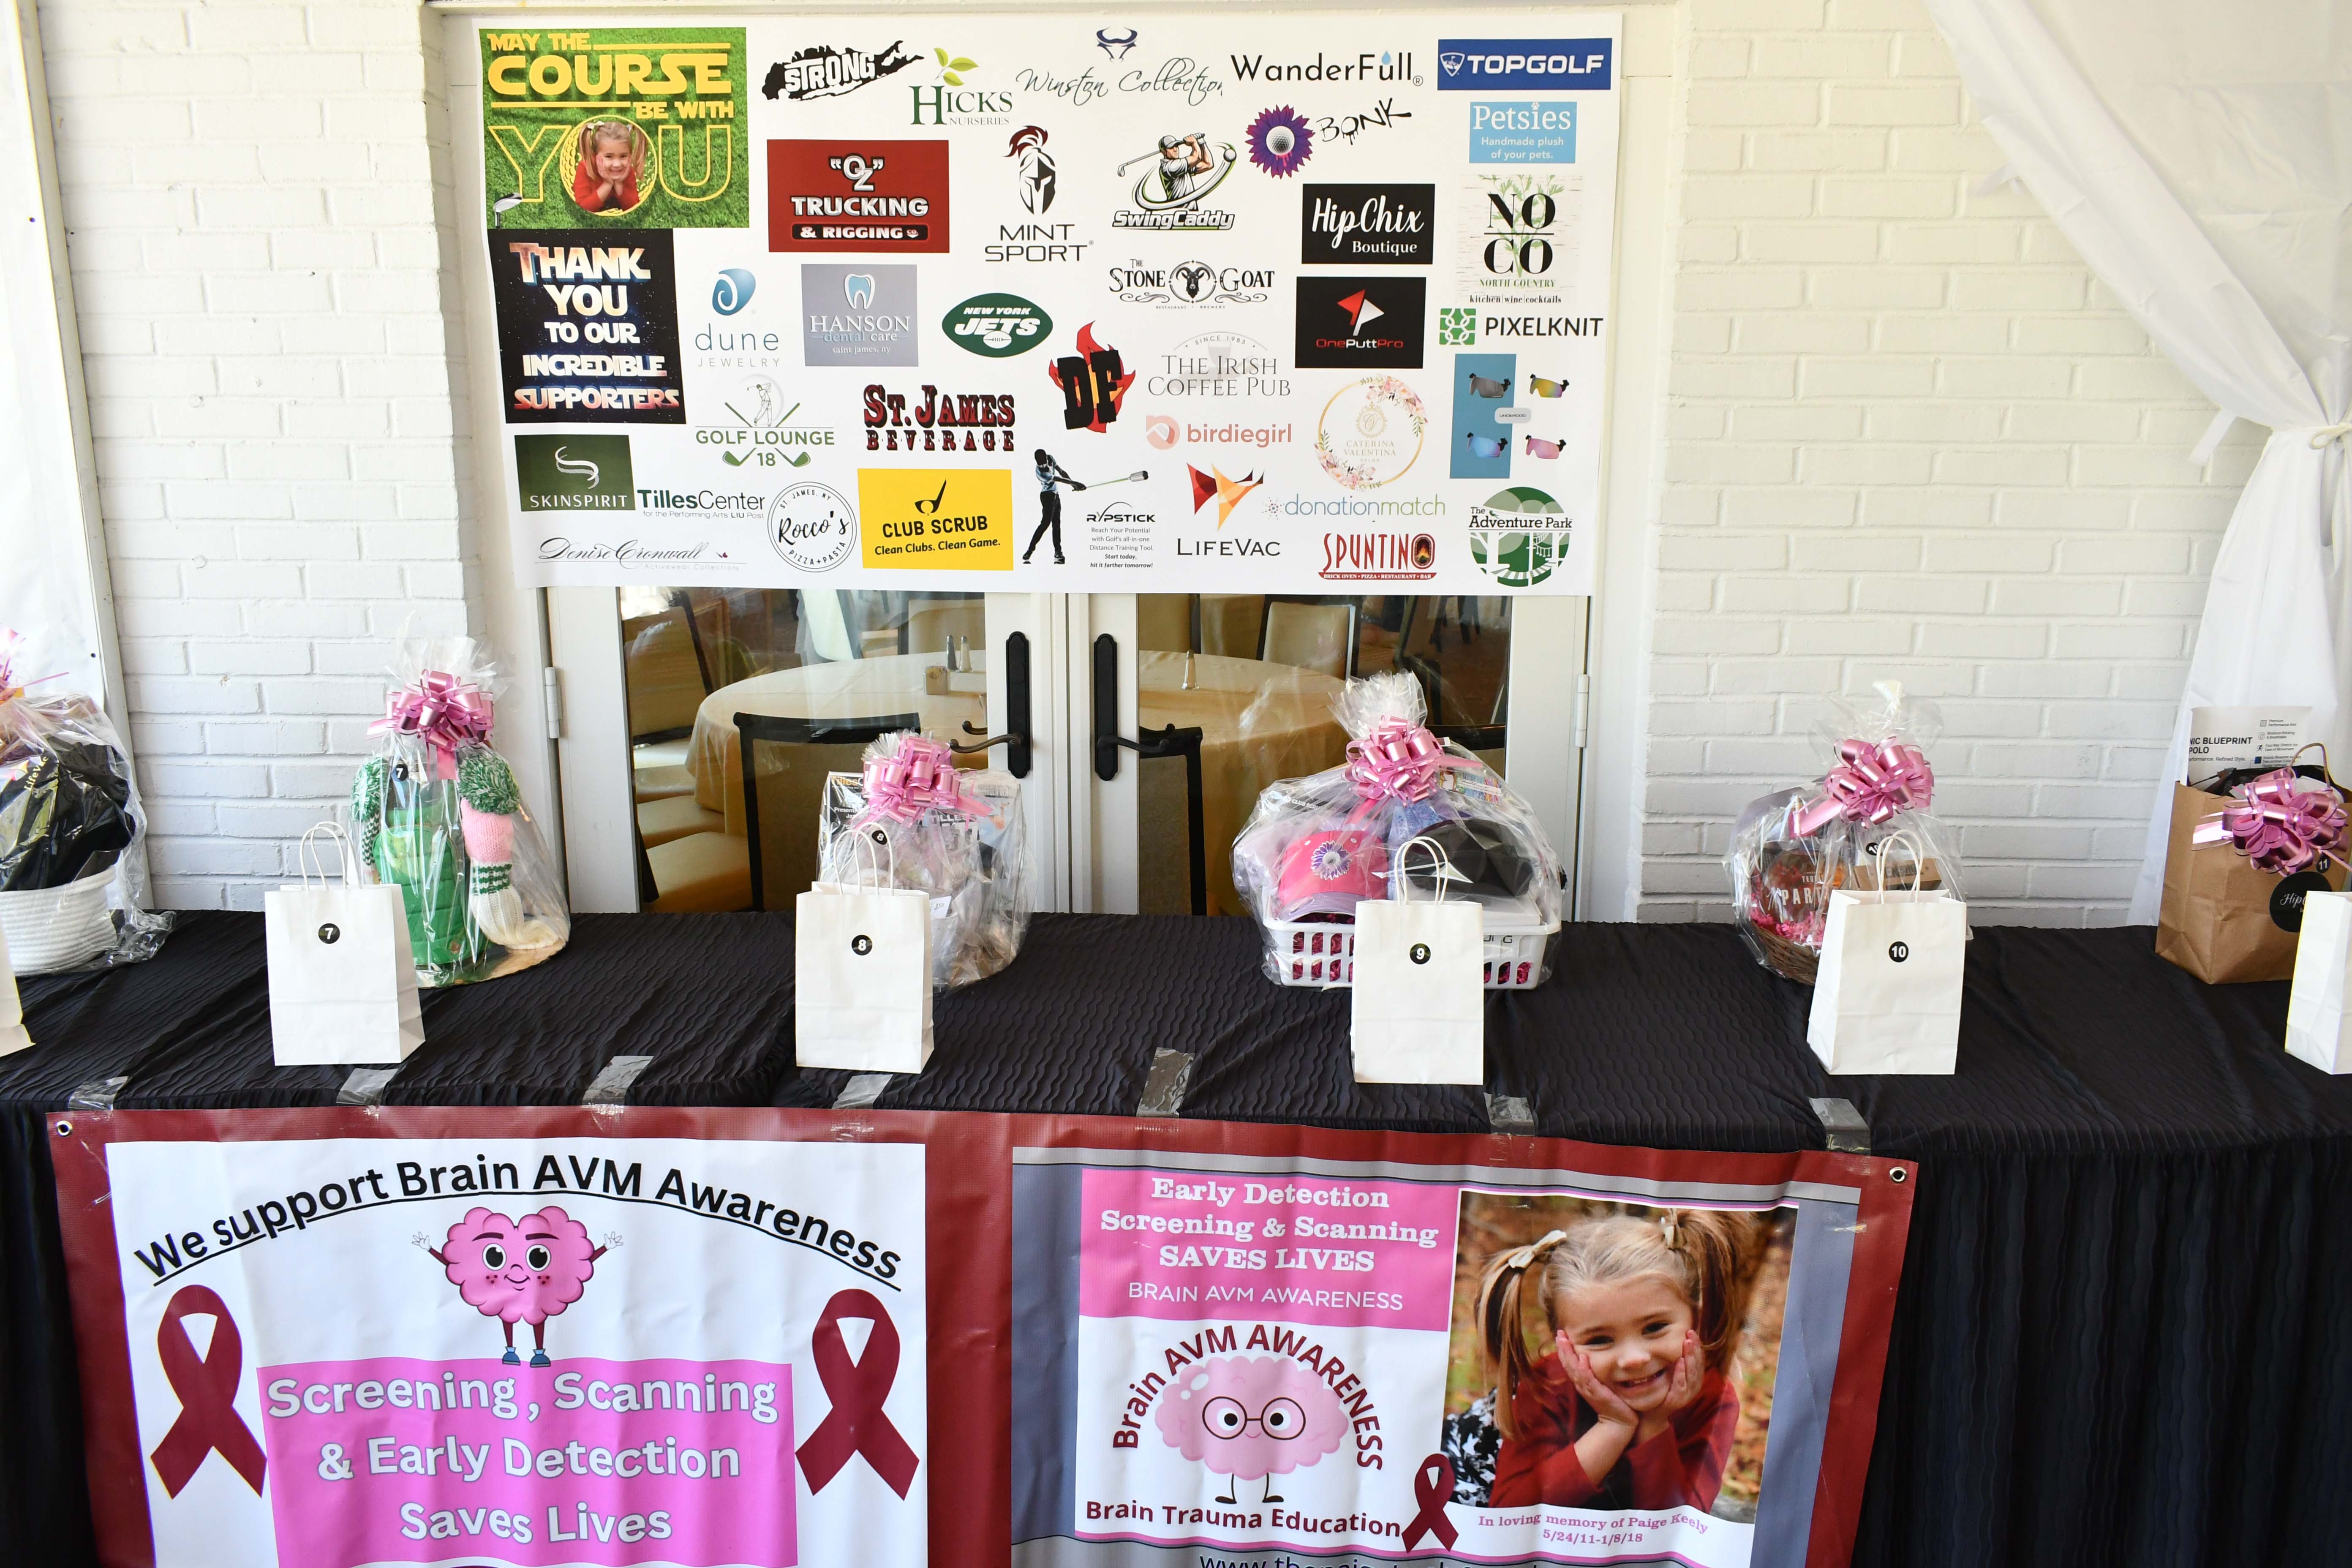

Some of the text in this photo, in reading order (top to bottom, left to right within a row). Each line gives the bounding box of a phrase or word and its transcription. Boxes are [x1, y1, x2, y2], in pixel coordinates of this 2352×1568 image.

[487, 33, 590, 51] MAY THE
[784, 52, 875, 93] STRONG
[1467, 55, 1604, 74] TOPGOLF
[488, 54, 731, 95] COURSE
[1015, 58, 1222, 106] Winston Collection
[633, 101, 733, 118] BE WITH
[909, 85, 1012, 125] HICKS
[1473, 102, 1571, 130] Petsies
[1481, 136, 1563, 147] Handmade plush
[1491, 150, 1553, 160] of your pets.
[791, 197, 928, 216] TRUCKING
[1487, 193, 1555, 229] NO
[1112, 210, 1235, 230] SwingCaddy
[800, 227, 903, 238] & RIGGING
[1001, 224, 1075, 240] MINT
[985, 245, 1087, 261] SPORT
[1352, 241, 1417, 256] Boutique
[1484, 238, 1553, 274] CO
[509, 242, 651, 284] THANK
[1109, 268, 1275, 292] STONE GOAT
[1480, 279, 1555, 287] NORTH COUNTRY
[543, 285, 628, 316] YOU
[544, 322, 640, 343] TO OUR
[810, 316, 910, 332] HANSON
[955, 318, 1040, 335] JETS
[1486, 317, 1603, 336] PIXELKNIT
[695, 324, 779, 351] dune
[824, 332, 865, 341] dental
[1195, 335, 1245, 345] SINCE 1983
[1316, 339, 1403, 348] OnePuttPro
[523, 355, 667, 376] INCREDIBLE
[698, 359, 780, 368] JEWELRY
[1162, 355, 1277, 375] THE IRISH
[1149, 377, 1290, 396] COFFEE PUB
[514, 387, 679, 409] SUPPORTERS
[696, 431, 834, 445] GOLF LOUNGE
[1188, 424, 1291, 448] birdiegirl
[757, 453, 776, 466] 18
[530, 495, 627, 508] SKINSPIRIT
[1285, 493, 1445, 515] donationmatch
[779, 511, 849, 545] Rocco's
[882, 516, 988, 538] CLUB SCRUB
[1469, 515, 1572, 528] Adventure Park
[875, 539, 1000, 555] Clean Clubs. Clean Game.
[1323, 534, 1435, 573] SPUNTINO
[396, 768, 403, 778] 7
[877, 833, 884, 841] 8
[2319, 859, 2328, 870] 11
[324, 927, 334, 939] 7
[858, 939, 866, 951] 8
[1416, 947, 1425, 960] 9
[1892, 946, 1906, 958] 10
[1152, 1177, 1389, 1208] Early Detection
[134, 1154, 901, 1279] We support Brain AVM Awareness
[1101, 1210, 1439, 1249] Screening & Scanning
[1160, 1245, 1375, 1271] SAVES LIVES
[1129, 1282, 1403, 1311] BRAIN AVM AWARENESS
[553, 1372, 778, 1423] Scanning
[1113, 1324, 1383, 1471] Brain AVM AWARENESS
[317, 1436, 740, 1481] & Early Detection
[400, 1502, 672, 1544] Saves Lives
[1086, 1501, 1401, 1537] Brain Trauma Education
[1478, 1513, 1708, 1534] In loving memory of Paige Keely
[1543, 1529, 1643, 1546] 5/24/11-1/8/18
